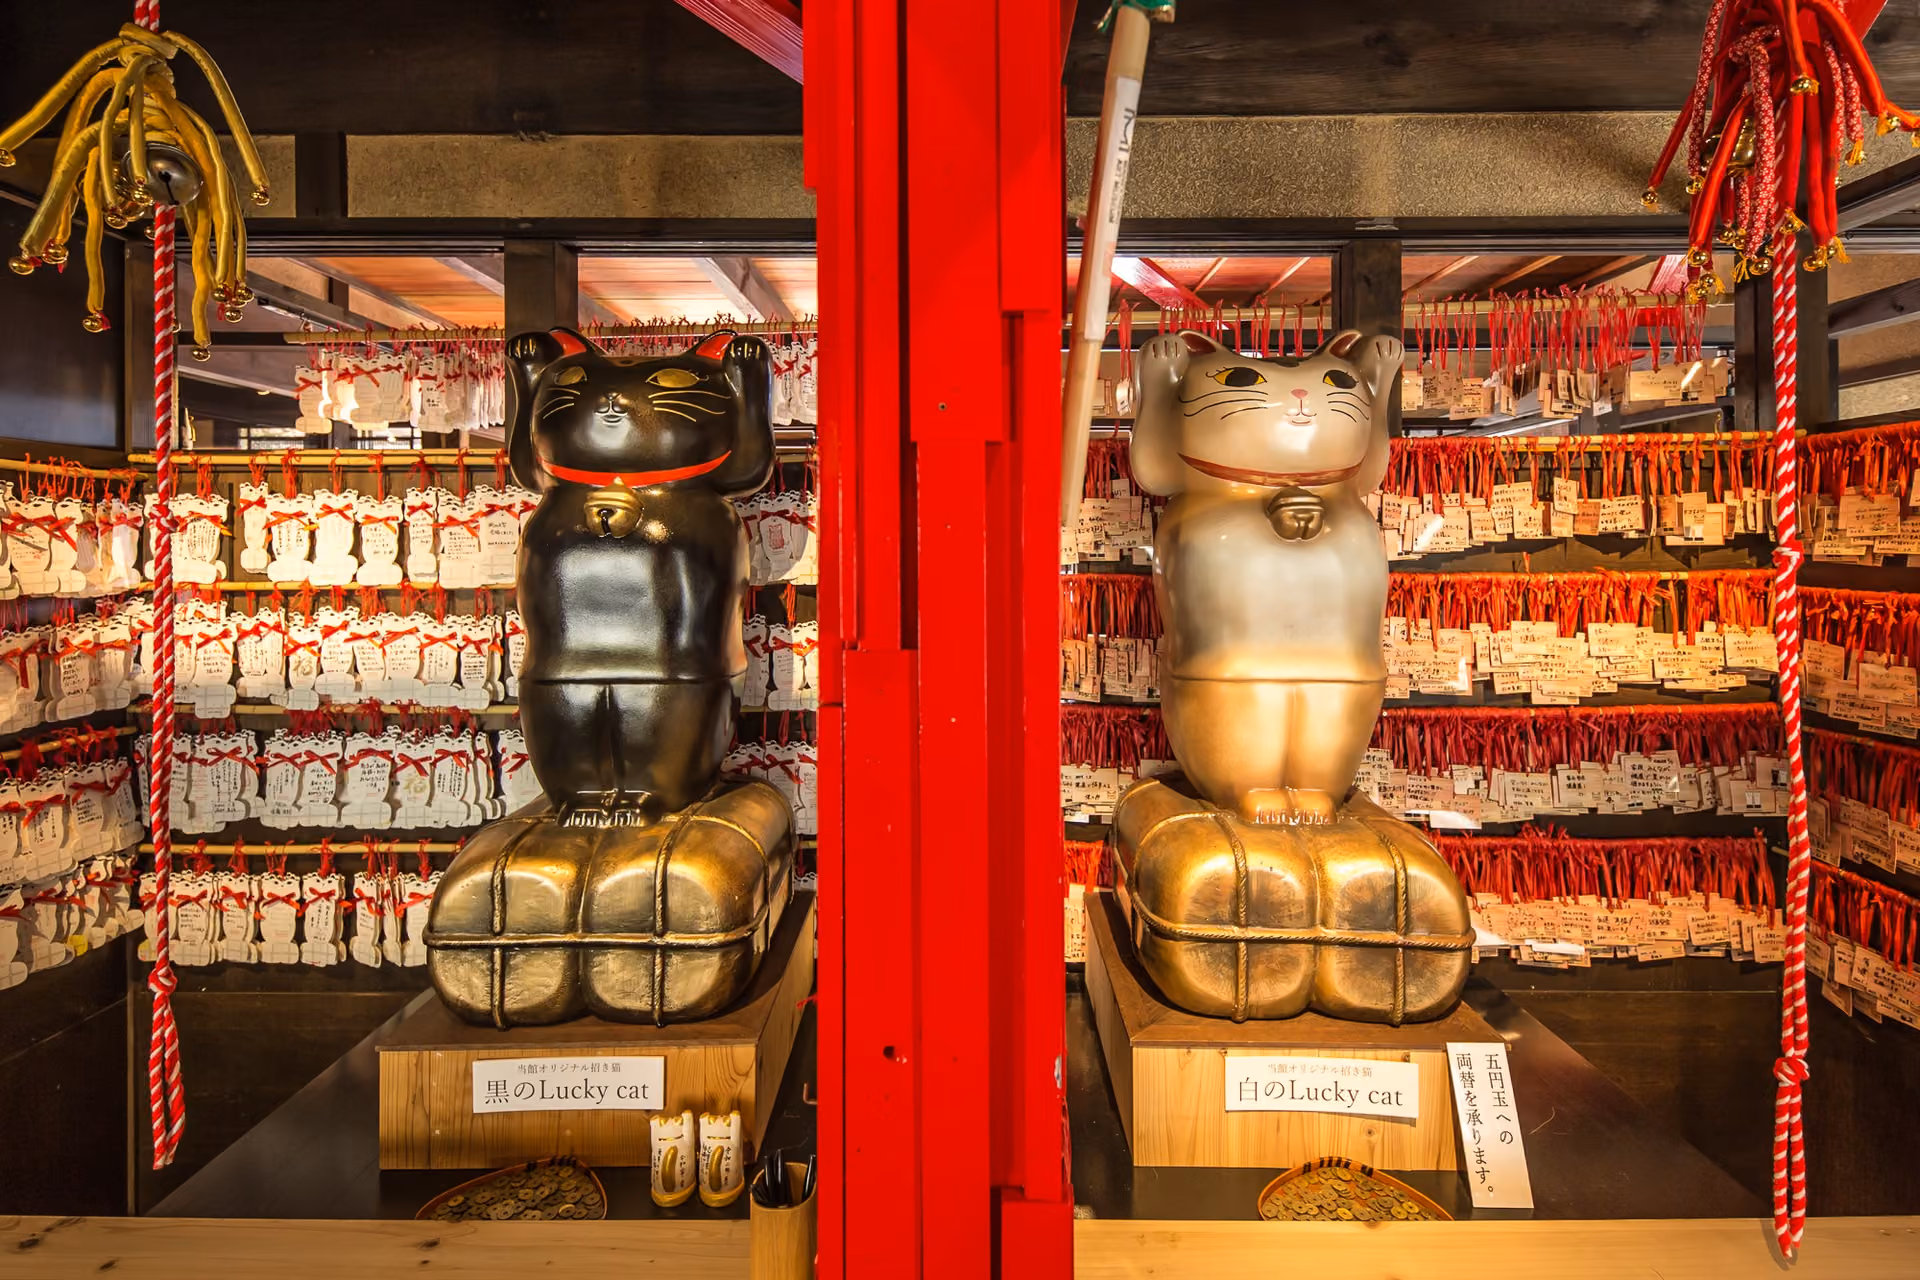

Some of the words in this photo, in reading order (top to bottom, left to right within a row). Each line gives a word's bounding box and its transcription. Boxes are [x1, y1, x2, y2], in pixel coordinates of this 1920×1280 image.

[517, 1062, 621, 1075] 当館オリジナル招き猫
[1268, 1063, 1373, 1077] 当館オリジナル招き猫
[616, 1083, 649, 1100] cat
[1368, 1090, 1403, 1107] cat
[1485, 1053, 1513, 1144] 五円玉への
[1456, 1053, 1494, 1192] 両替を承ります。
